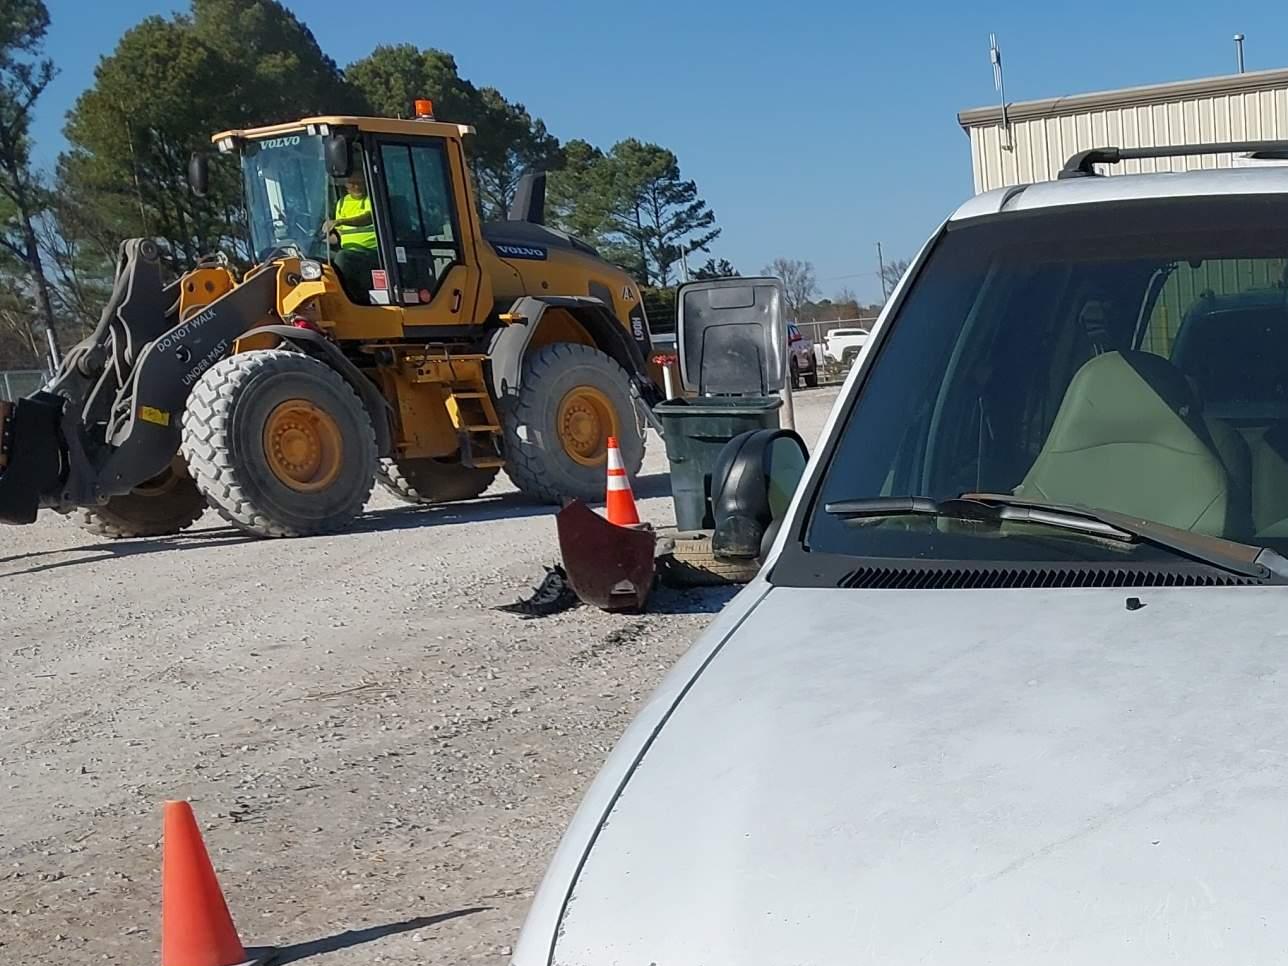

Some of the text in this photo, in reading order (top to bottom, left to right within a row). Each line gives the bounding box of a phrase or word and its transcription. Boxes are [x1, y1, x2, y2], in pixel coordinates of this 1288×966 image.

[260, 135, 300, 150] VOLVO
[496, 245, 544, 257] VOLVO
[156, 308, 217, 353] DO NOT WALK
[181, 338, 229, 386] UNDER MAST
